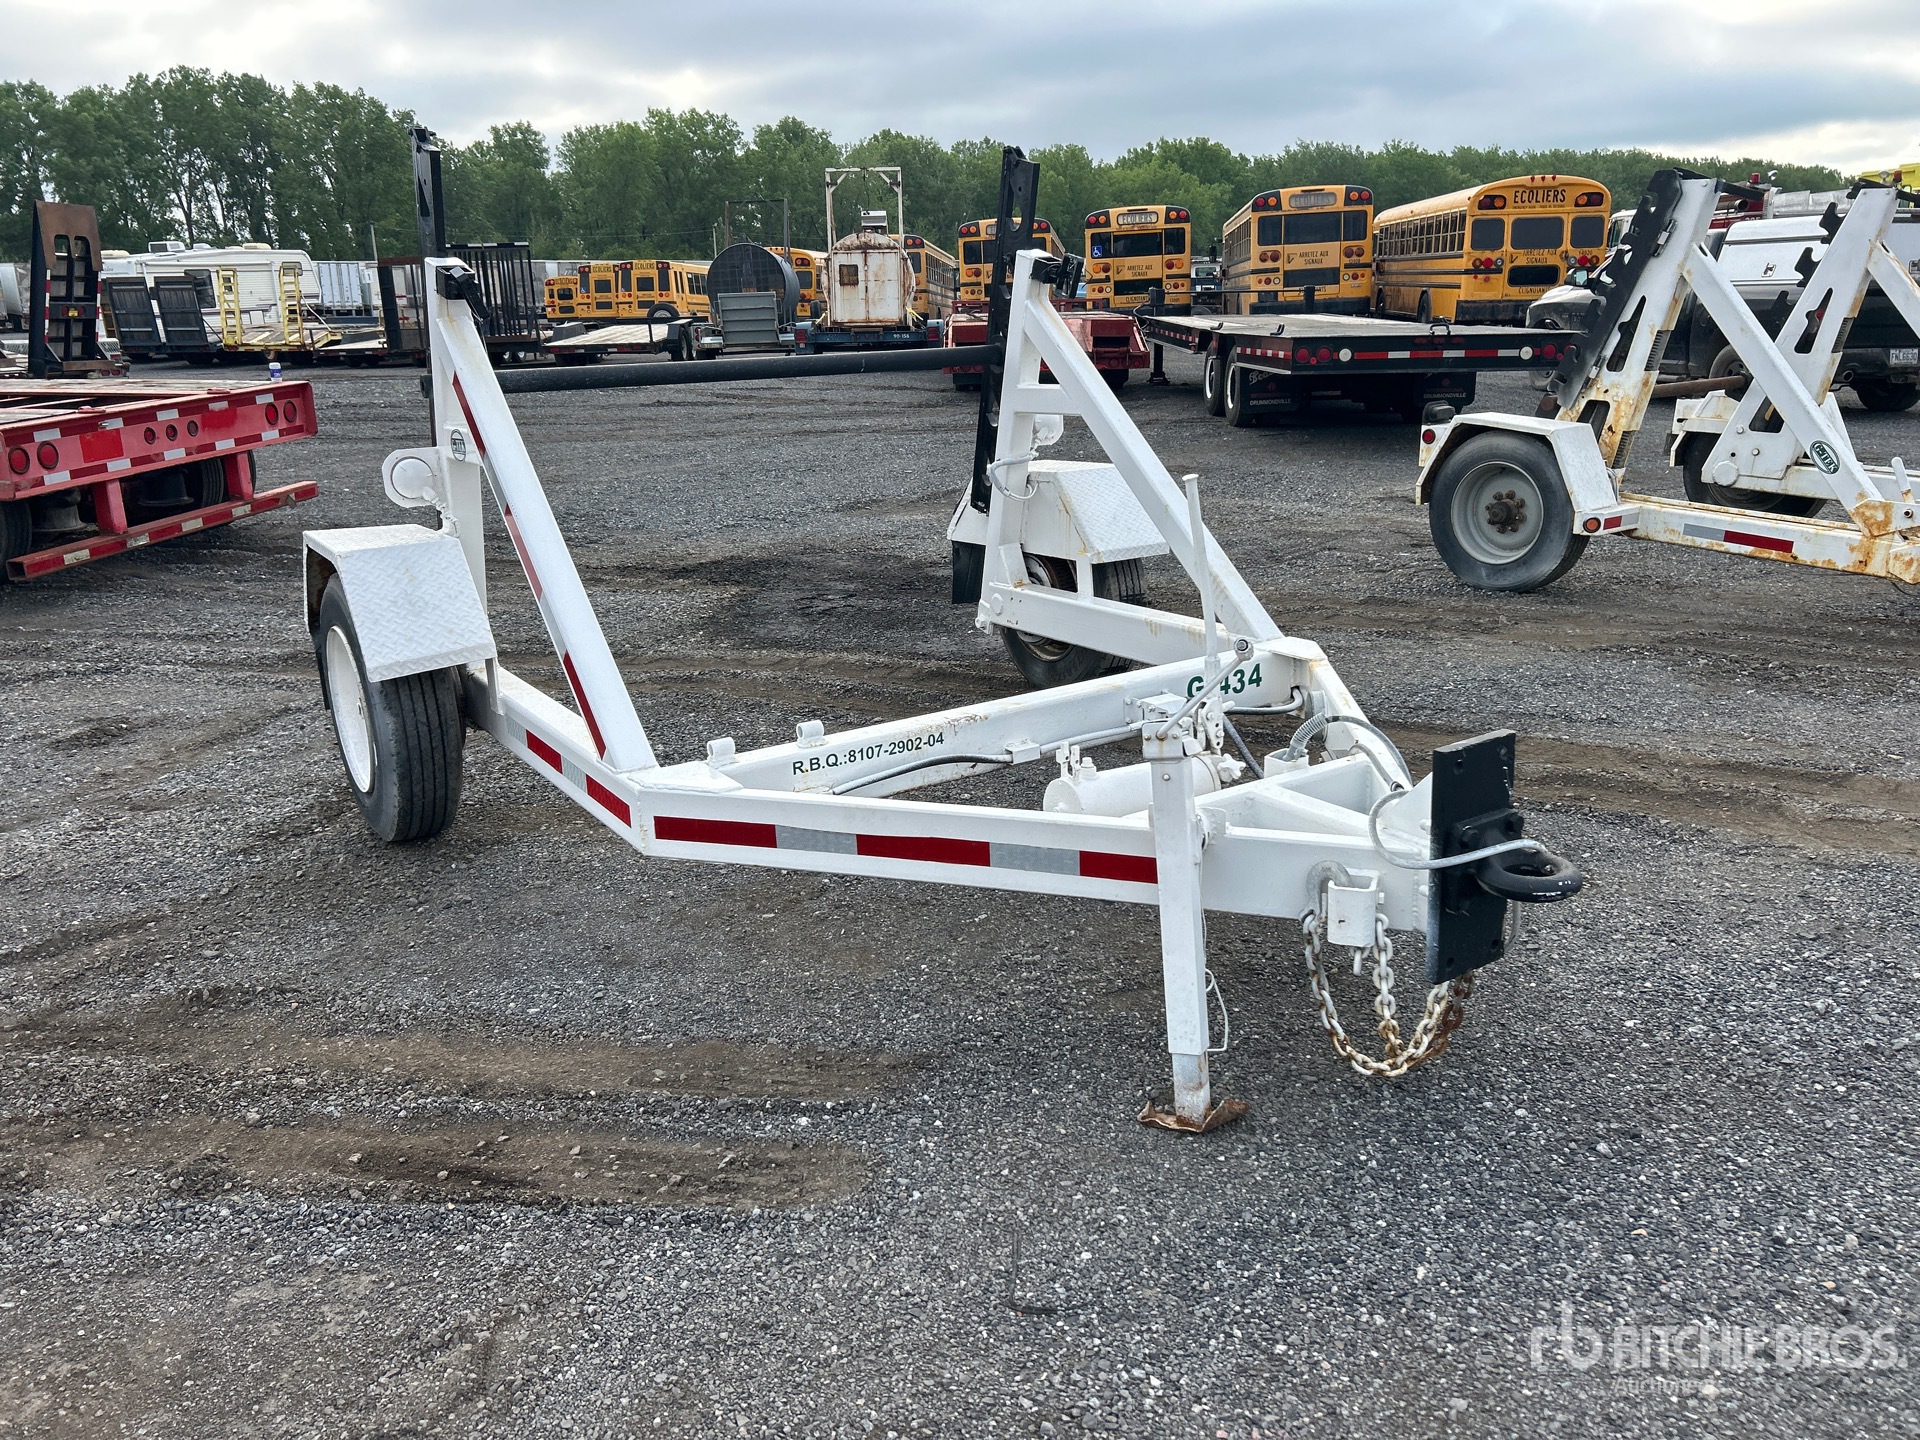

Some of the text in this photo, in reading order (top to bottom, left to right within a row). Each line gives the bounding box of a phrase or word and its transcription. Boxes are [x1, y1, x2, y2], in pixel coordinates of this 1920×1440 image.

[1295, 196, 1331, 206] ECOLIERS
[1514, 189, 1566, 204] ECOLIERS
[1122, 213, 1153, 224] ECOLIERS
[1526, 257, 1548, 265] SIGNAUX
[1249, 398, 1291, 406] DRUMMONDVILLE
[1812, 442, 1839, 474] G-TEK
[792, 732, 945, 776] R.B.Q.:8107-2902-04
